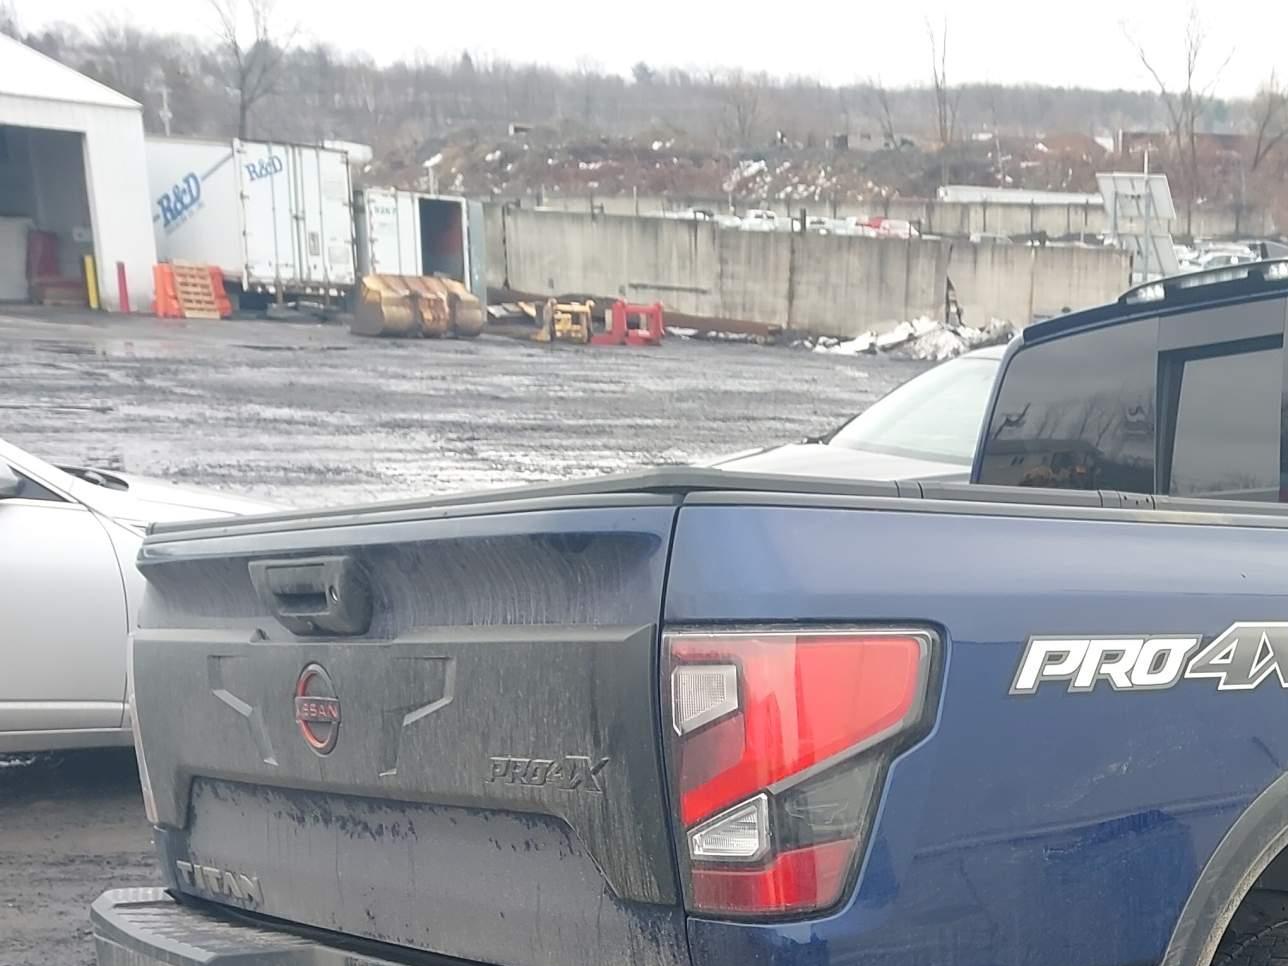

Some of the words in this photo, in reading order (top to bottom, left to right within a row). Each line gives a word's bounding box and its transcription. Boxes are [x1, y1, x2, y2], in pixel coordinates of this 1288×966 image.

[245, 155, 283, 181] R&D
[157, 172, 201, 228] R&D
[295, 702, 338, 720] NSSAN
[176, 860, 265, 909] TITAN
